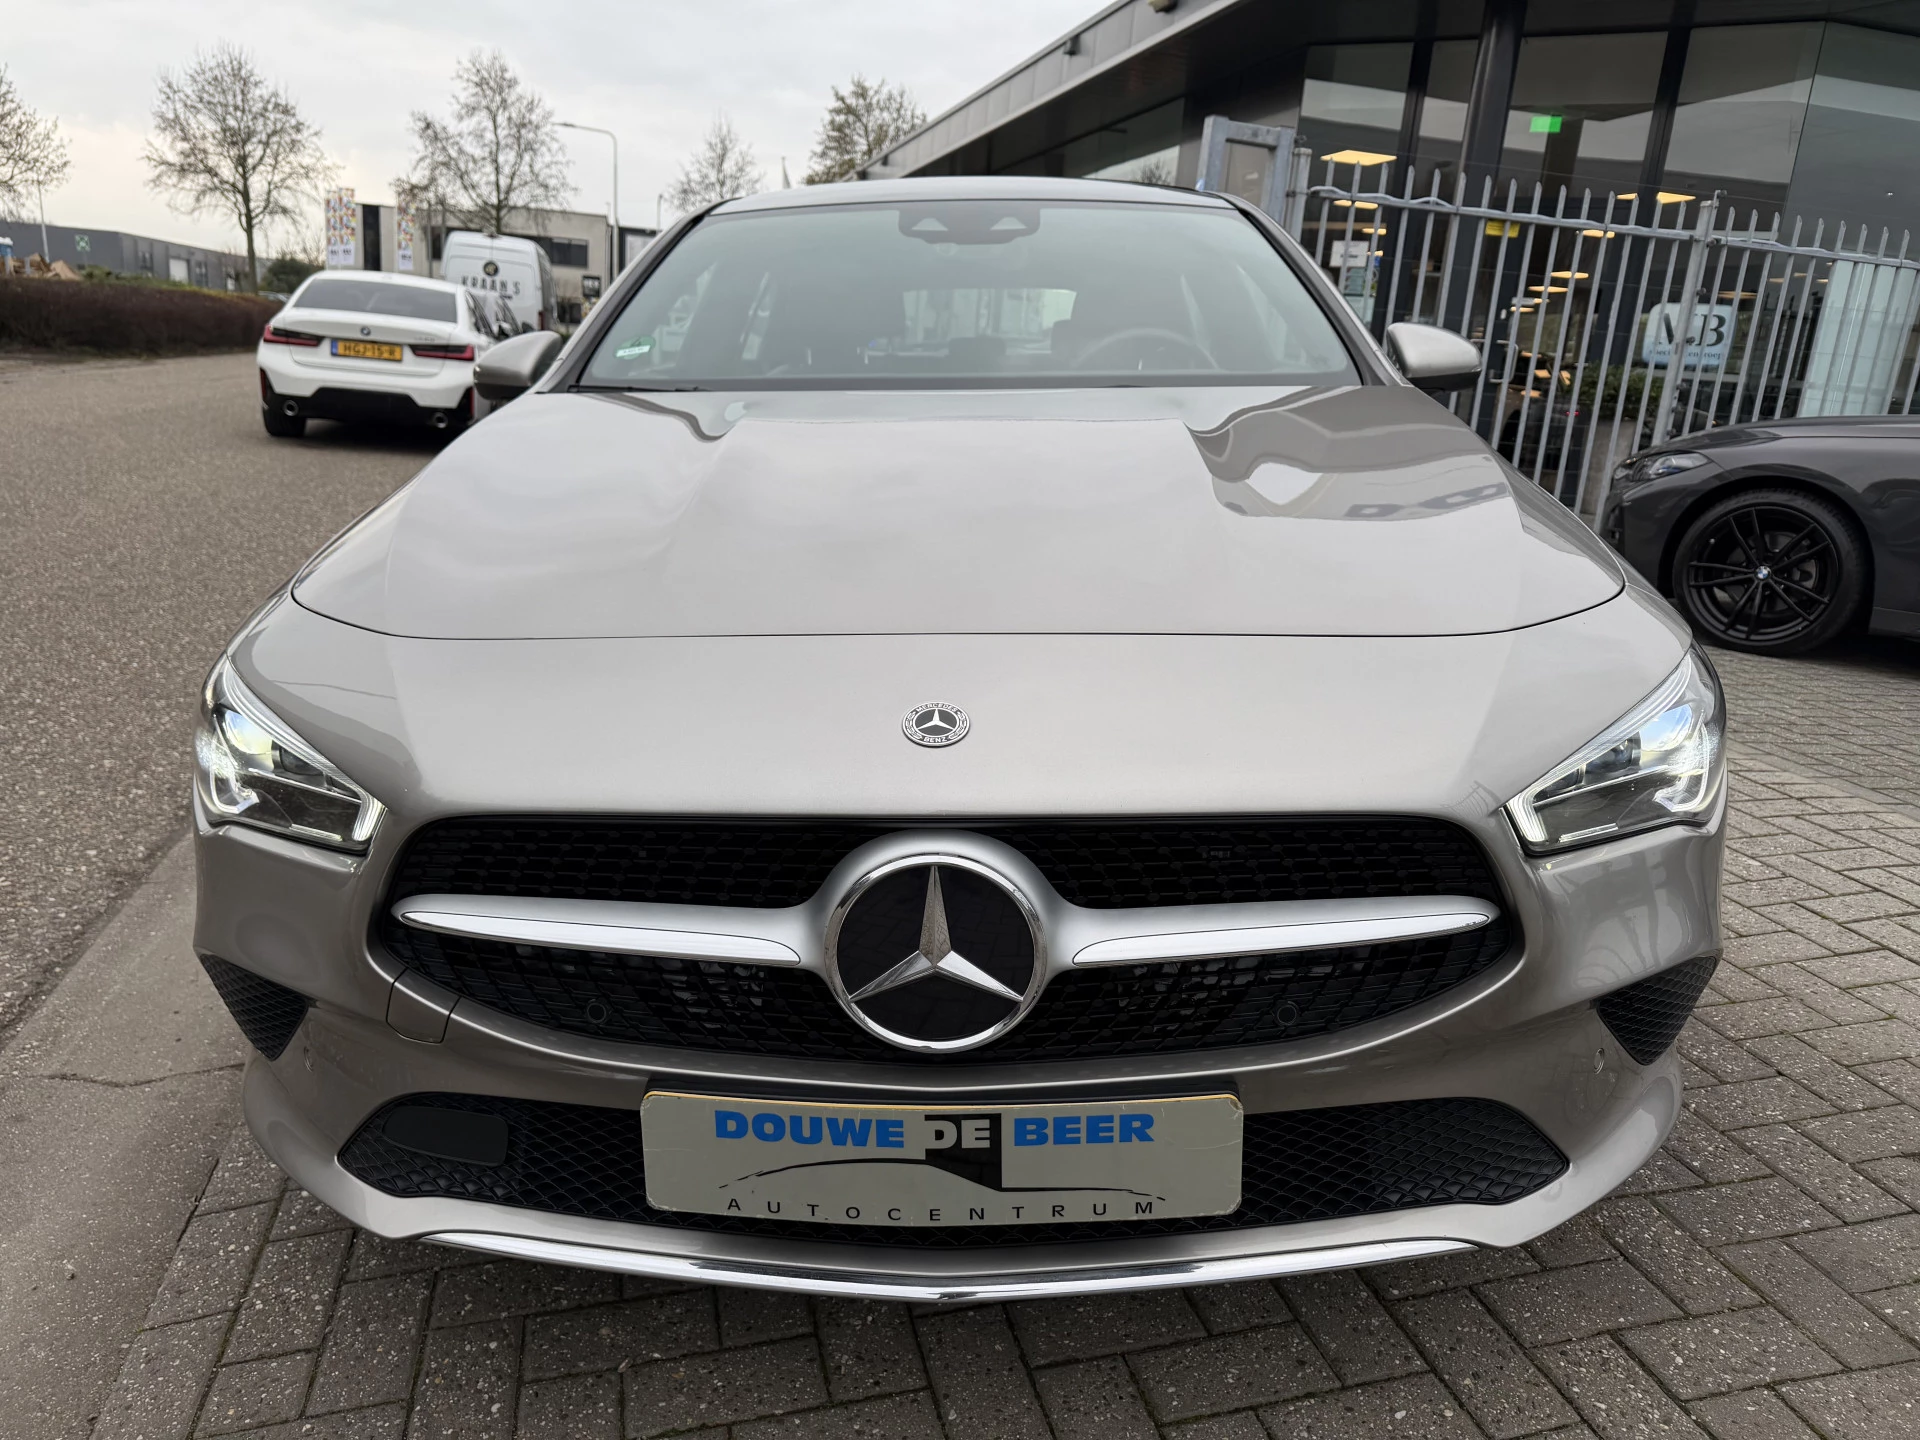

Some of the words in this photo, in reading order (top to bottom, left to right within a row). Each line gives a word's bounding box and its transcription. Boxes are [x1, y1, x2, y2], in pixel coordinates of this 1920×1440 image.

[915, 702, 959, 712] MERCEDES
[714, 1109, 904, 1148] DOUWE
[924, 1119, 991, 1149] DE
[1013, 1113, 1155, 1147] BEER
[726, 1198, 1154, 1221] AUTOCENTRUM
